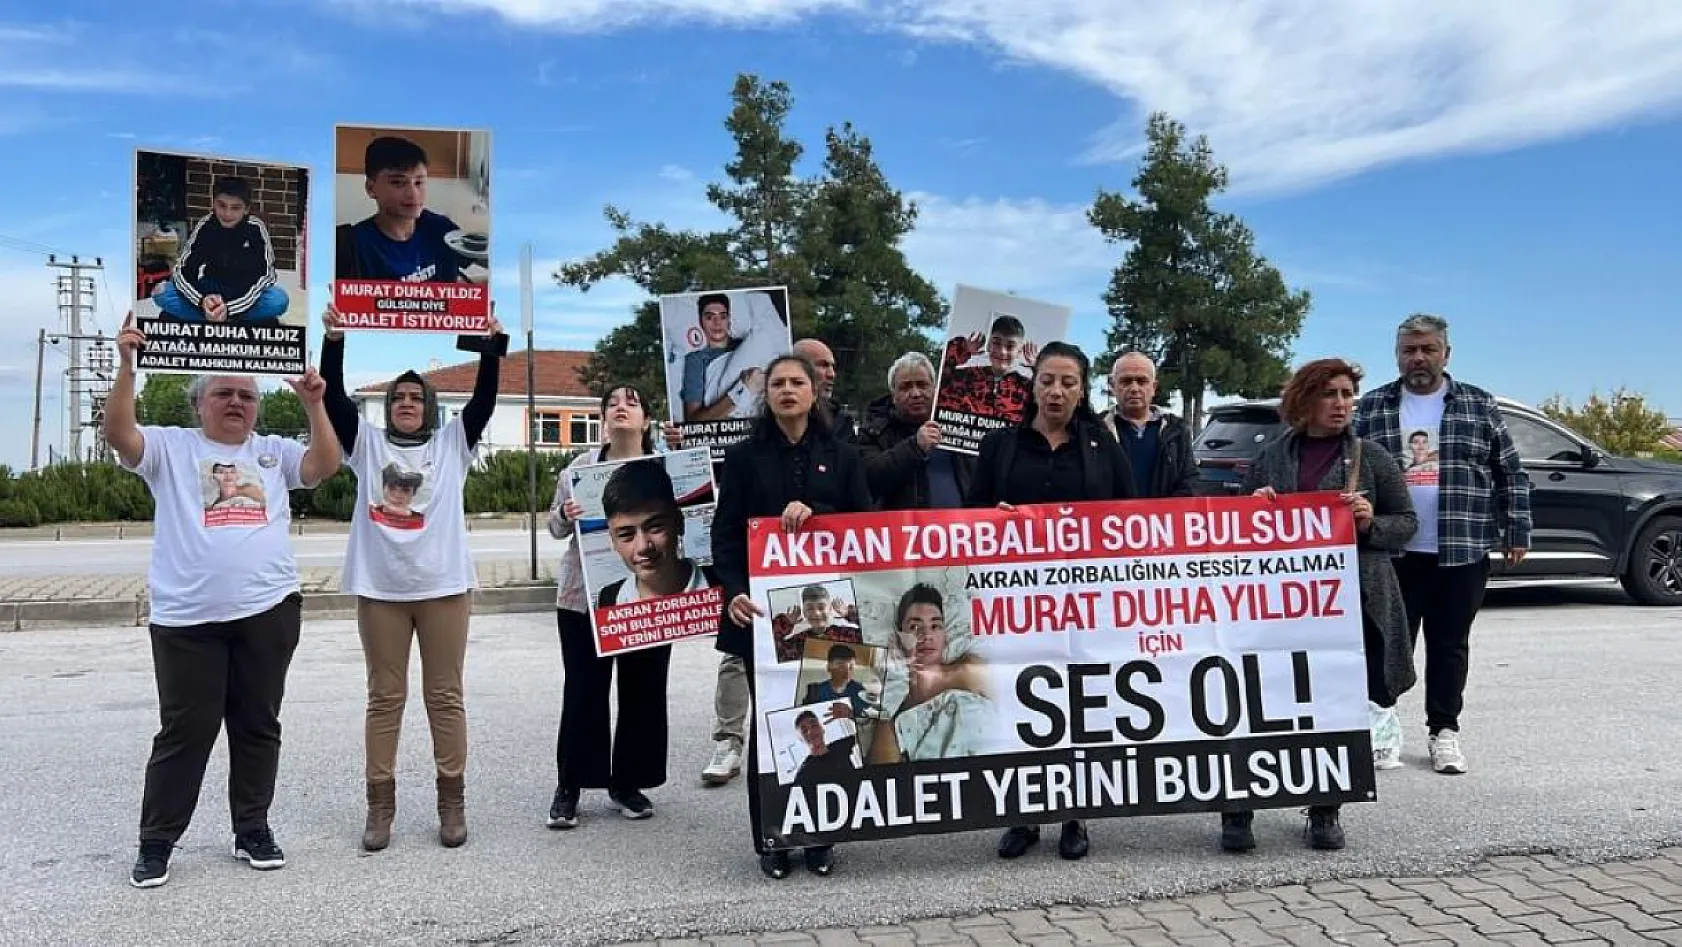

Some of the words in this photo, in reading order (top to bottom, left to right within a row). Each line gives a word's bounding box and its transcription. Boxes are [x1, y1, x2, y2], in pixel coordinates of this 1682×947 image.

[341, 283, 393, 297] MURAT
[394, 285, 435, 299] DUHA
[437, 286, 482, 299] YILDIZ
[376, 298, 420, 310] GÜLSÜN
[422, 300, 446, 311] DİYE
[337, 312, 399, 327] ADALET
[402, 311, 485, 329] İSTİYORUZ
[143, 321, 201, 337] MURAT
[204, 325, 249, 339] DUHA
[251, 327, 300, 342] YILDIZ
[199, 343, 261, 357] MAHKUM
[263, 346, 300, 359] KALDI
[140, 356, 187, 368] ADALET
[189, 358, 243, 370] MAHKUM
[938, 409, 976, 426] MURAT
[941, 423, 970, 437] ATAĞA
[684, 436, 717, 448] ATAĞA
[760, 526, 893, 568] AKRAN
[901, 506, 1093, 561] ZORBALIĞI
[1101, 512, 1175, 551] SON
[1184, 506, 1332, 547] BULSUN
[965, 569, 1038, 590] AKRAN
[1045, 559, 1181, 585] ZORBALIĞINA
[1186, 554, 1254, 578] SESSİZ
[1259, 552, 1346, 575] KALMA!
[607, 602, 652, 621] AKRAN
[970, 591, 1101, 637] MURAT
[1113, 584, 1216, 628] DUHA
[1221, 579, 1345, 621] YILDIZ
[600, 623, 628, 636] SON
[629, 612, 681, 632] BULSUN
[618, 627, 662, 647] YERİNİ
[1138, 630, 1183, 658] İÇİN
[1015, 660, 1165, 748] SES
[1189, 650, 1314, 738] OL!
[781, 771, 970, 835] ADALET
[982, 747, 1139, 816] YERİNİ
[1155, 746, 1351, 803] BULSUN
